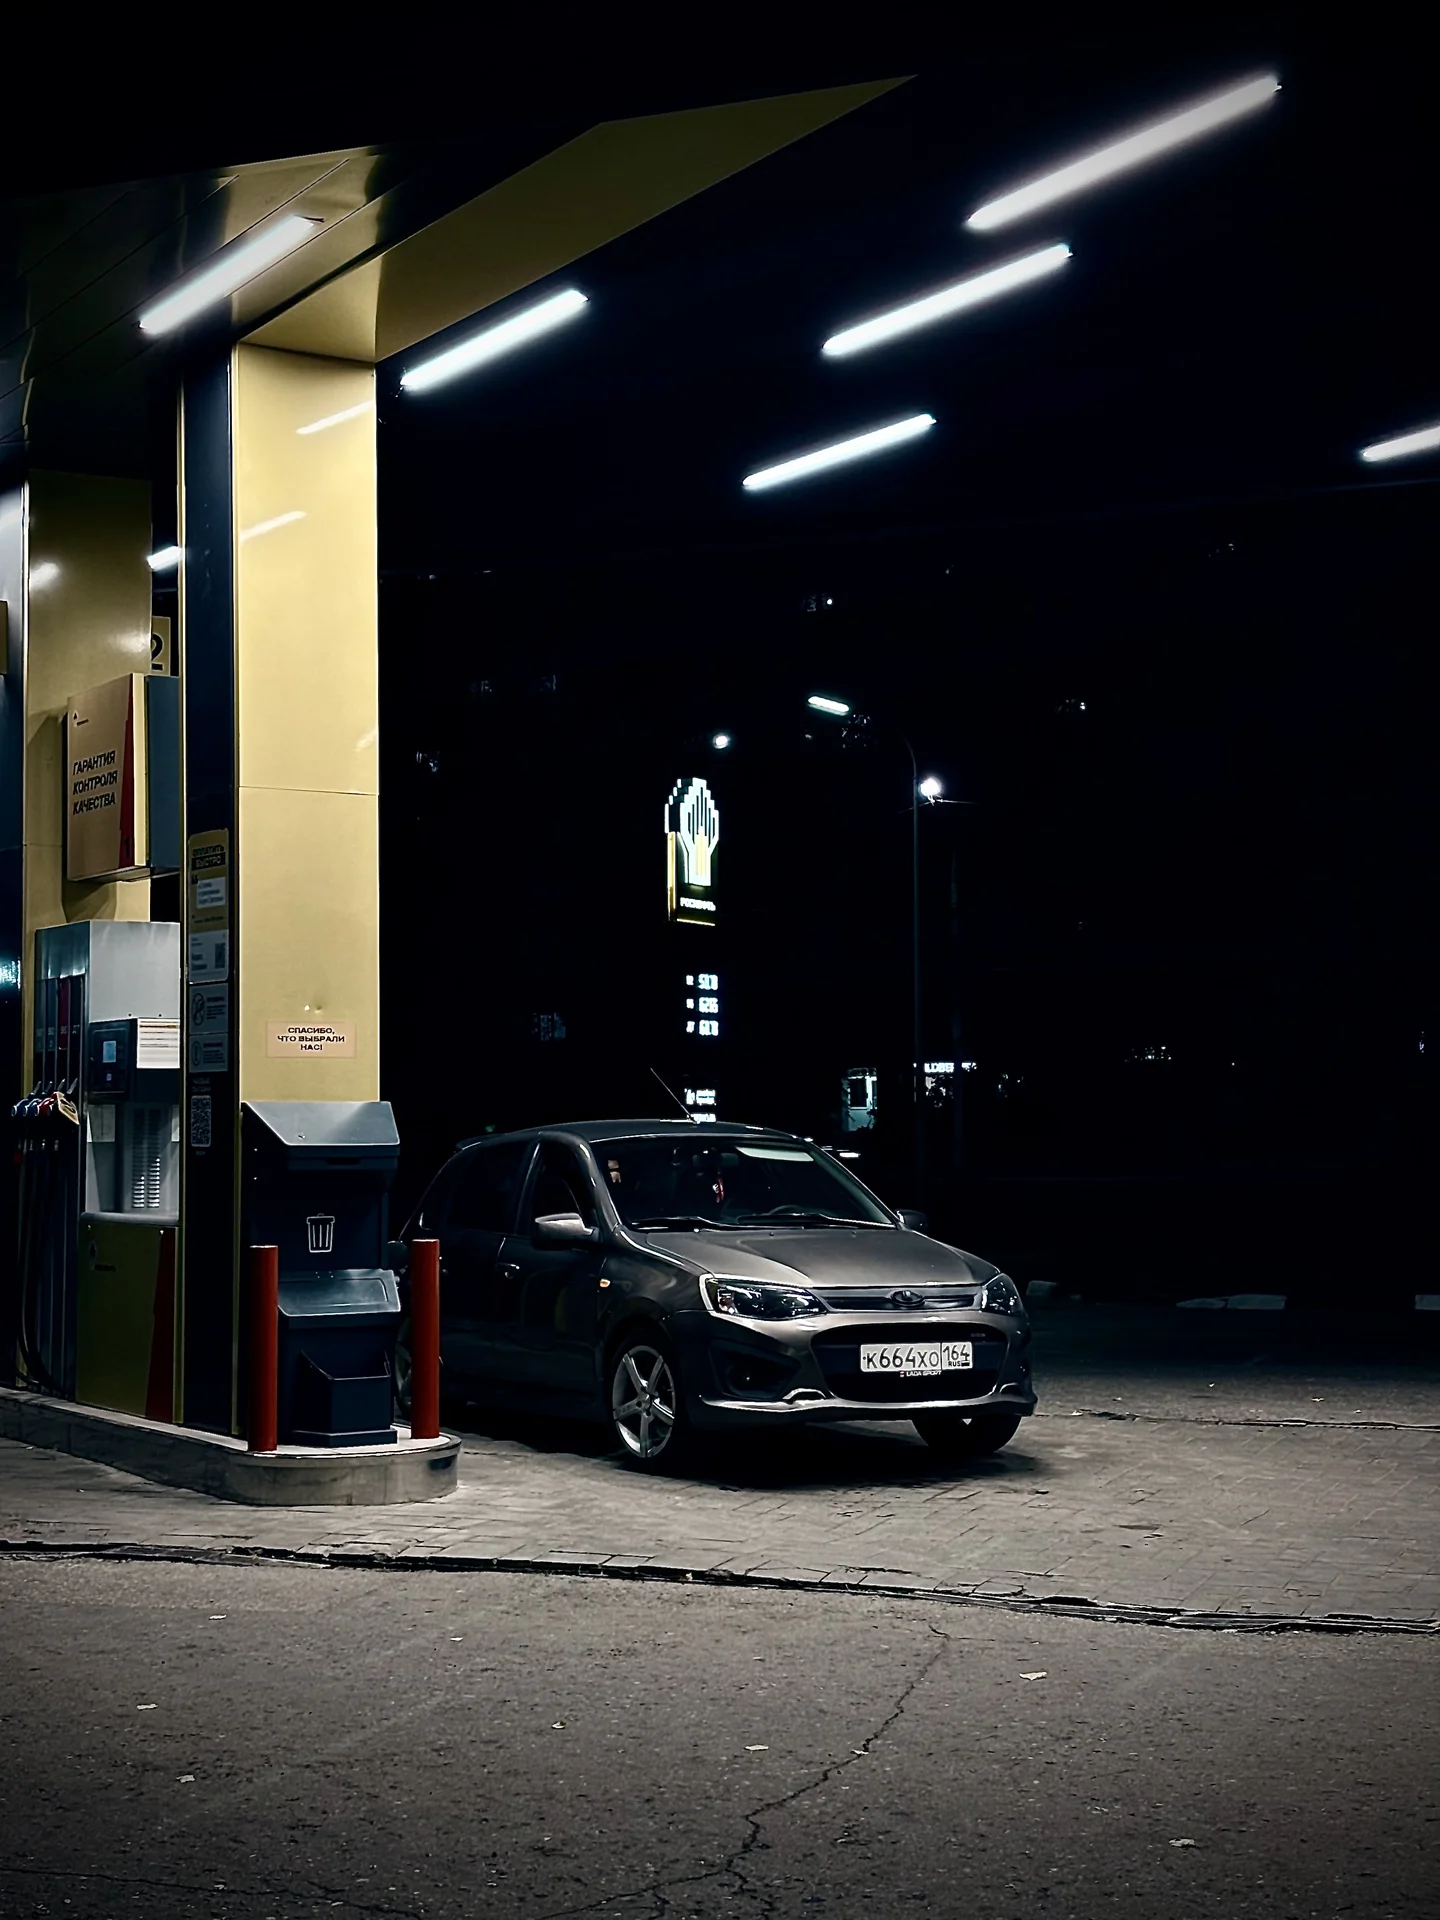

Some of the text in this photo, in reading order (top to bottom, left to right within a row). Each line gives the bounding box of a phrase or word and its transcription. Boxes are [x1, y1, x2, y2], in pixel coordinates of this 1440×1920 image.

[72, 749, 116, 776] ГАРАНТИЯ
[72, 769, 118, 796] КОНТРОЛЯ
[72, 790, 116, 815] КАЧЕСТВА
[287, 1027, 335, 1035] СПАСИБО,
[277, 1035, 345, 1043] ЧТО ВЫБРАЛИ
[300, 1043, 323, 1051] НАС!
[942, 1344, 970, 1361] 164
[922, 1369, 942, 1377] SPORT
